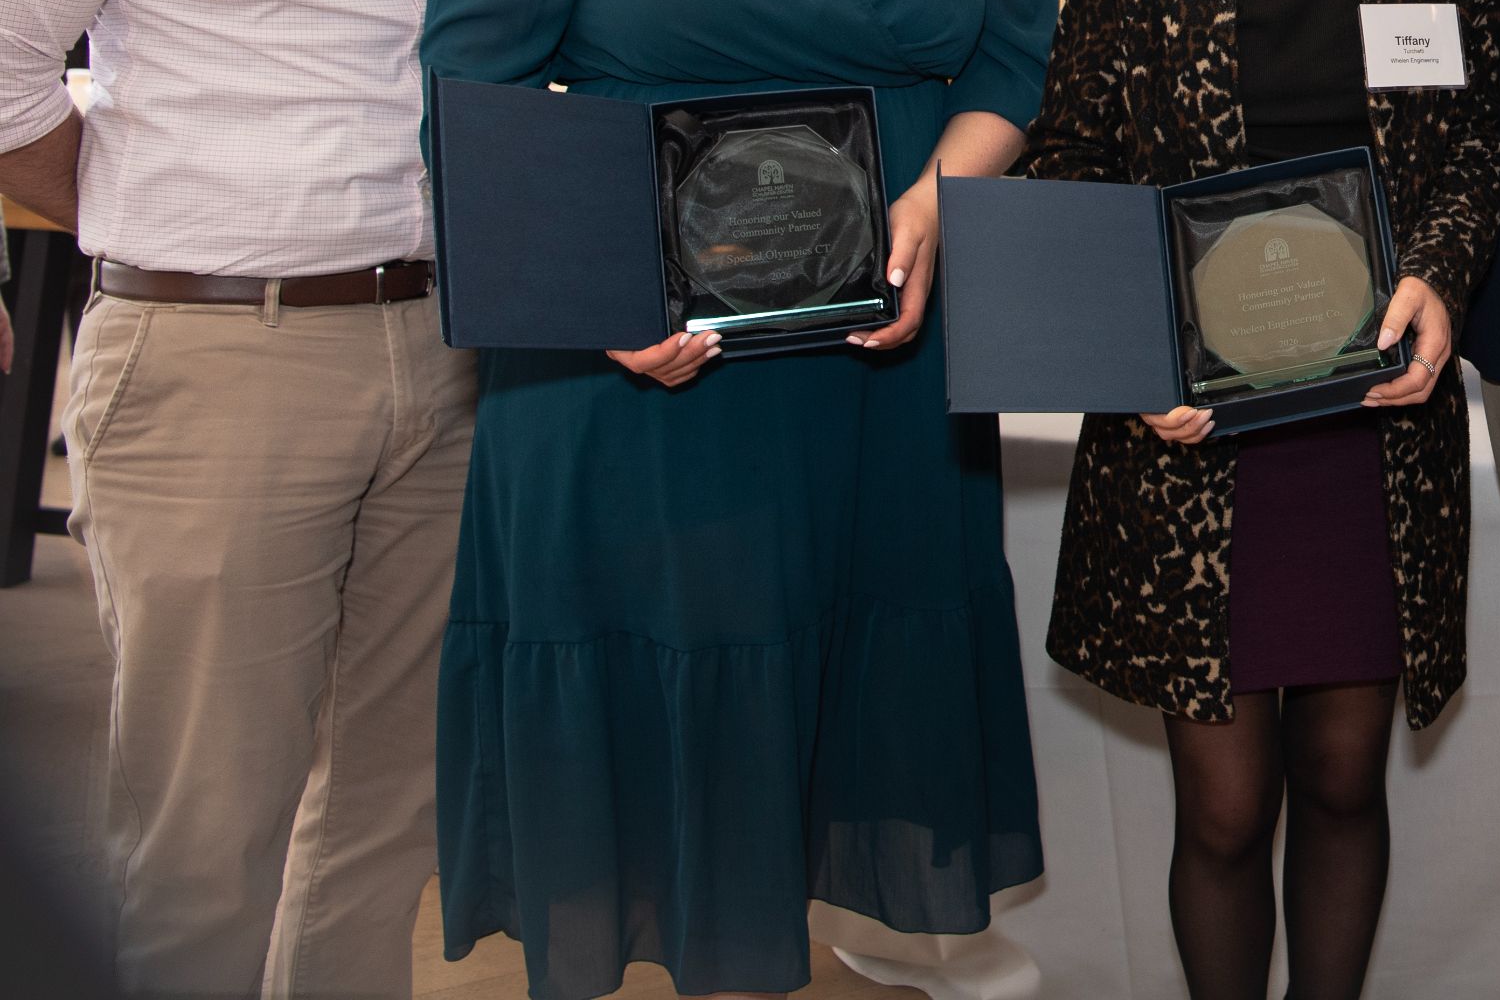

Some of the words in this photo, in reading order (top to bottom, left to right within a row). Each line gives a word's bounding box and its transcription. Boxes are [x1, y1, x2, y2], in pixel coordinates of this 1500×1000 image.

[1395, 36, 1430, 47] Tiffany
[729, 215, 772, 226] Honoring
[773, 213, 789, 221] our
[790, 208, 822, 219] Valued
[732, 225, 785, 239] Community
[789, 222, 821, 233] Partner
[727, 252, 762, 265] Special
[765, 247, 812, 261] Olympics
[814, 244, 831, 254] CT
[770, 271, 792, 281] 2026
[1238, 288, 1279, 302] Honoring
[1296, 278, 1326, 289] Valued
[1242, 297, 1292, 312] Community
[1294, 290, 1324, 302] Partner
[1230, 324, 1265, 337] Whelen
[1267, 312, 1323, 330] Engineering
[1326, 309, 1343, 319] Co.
